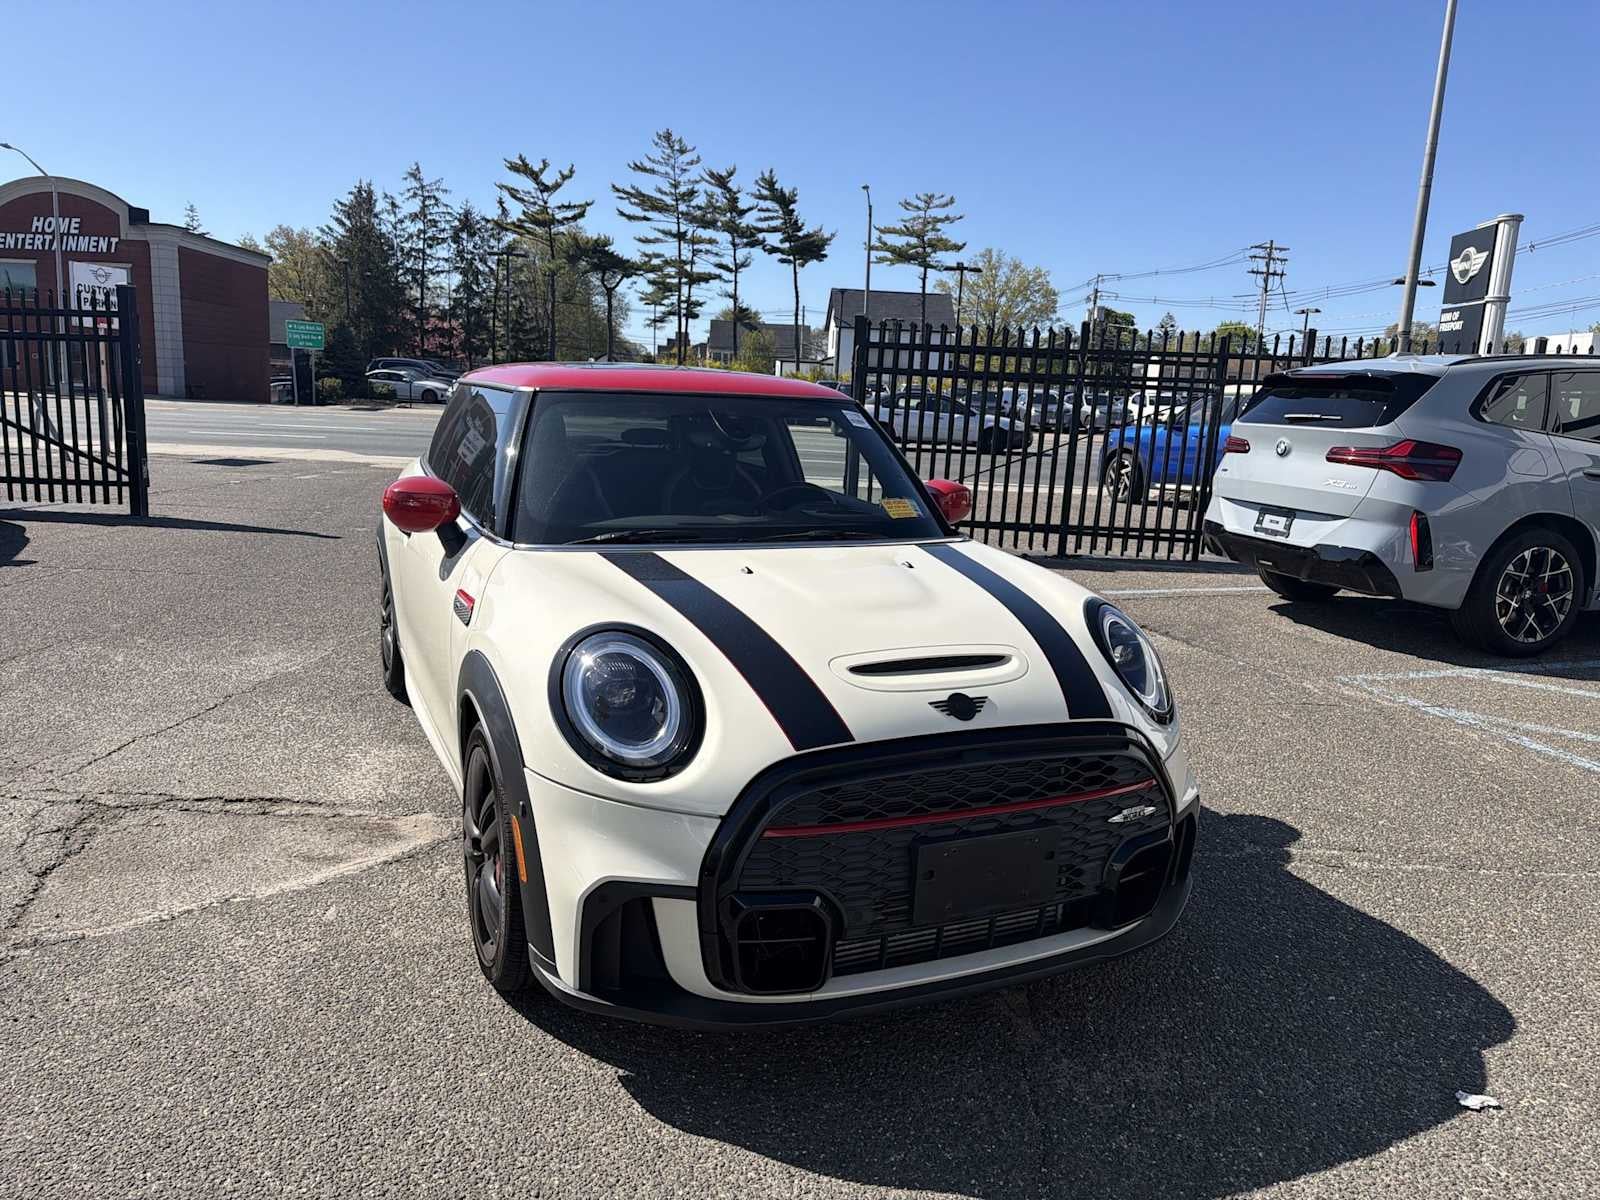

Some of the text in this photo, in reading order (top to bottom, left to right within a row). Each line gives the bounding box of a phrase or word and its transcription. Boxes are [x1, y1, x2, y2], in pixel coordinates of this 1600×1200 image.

[31, 216, 80, 233] HOME
[77, 283, 116, 297] CUSTOM
[1452, 311, 1460, 320] OF
